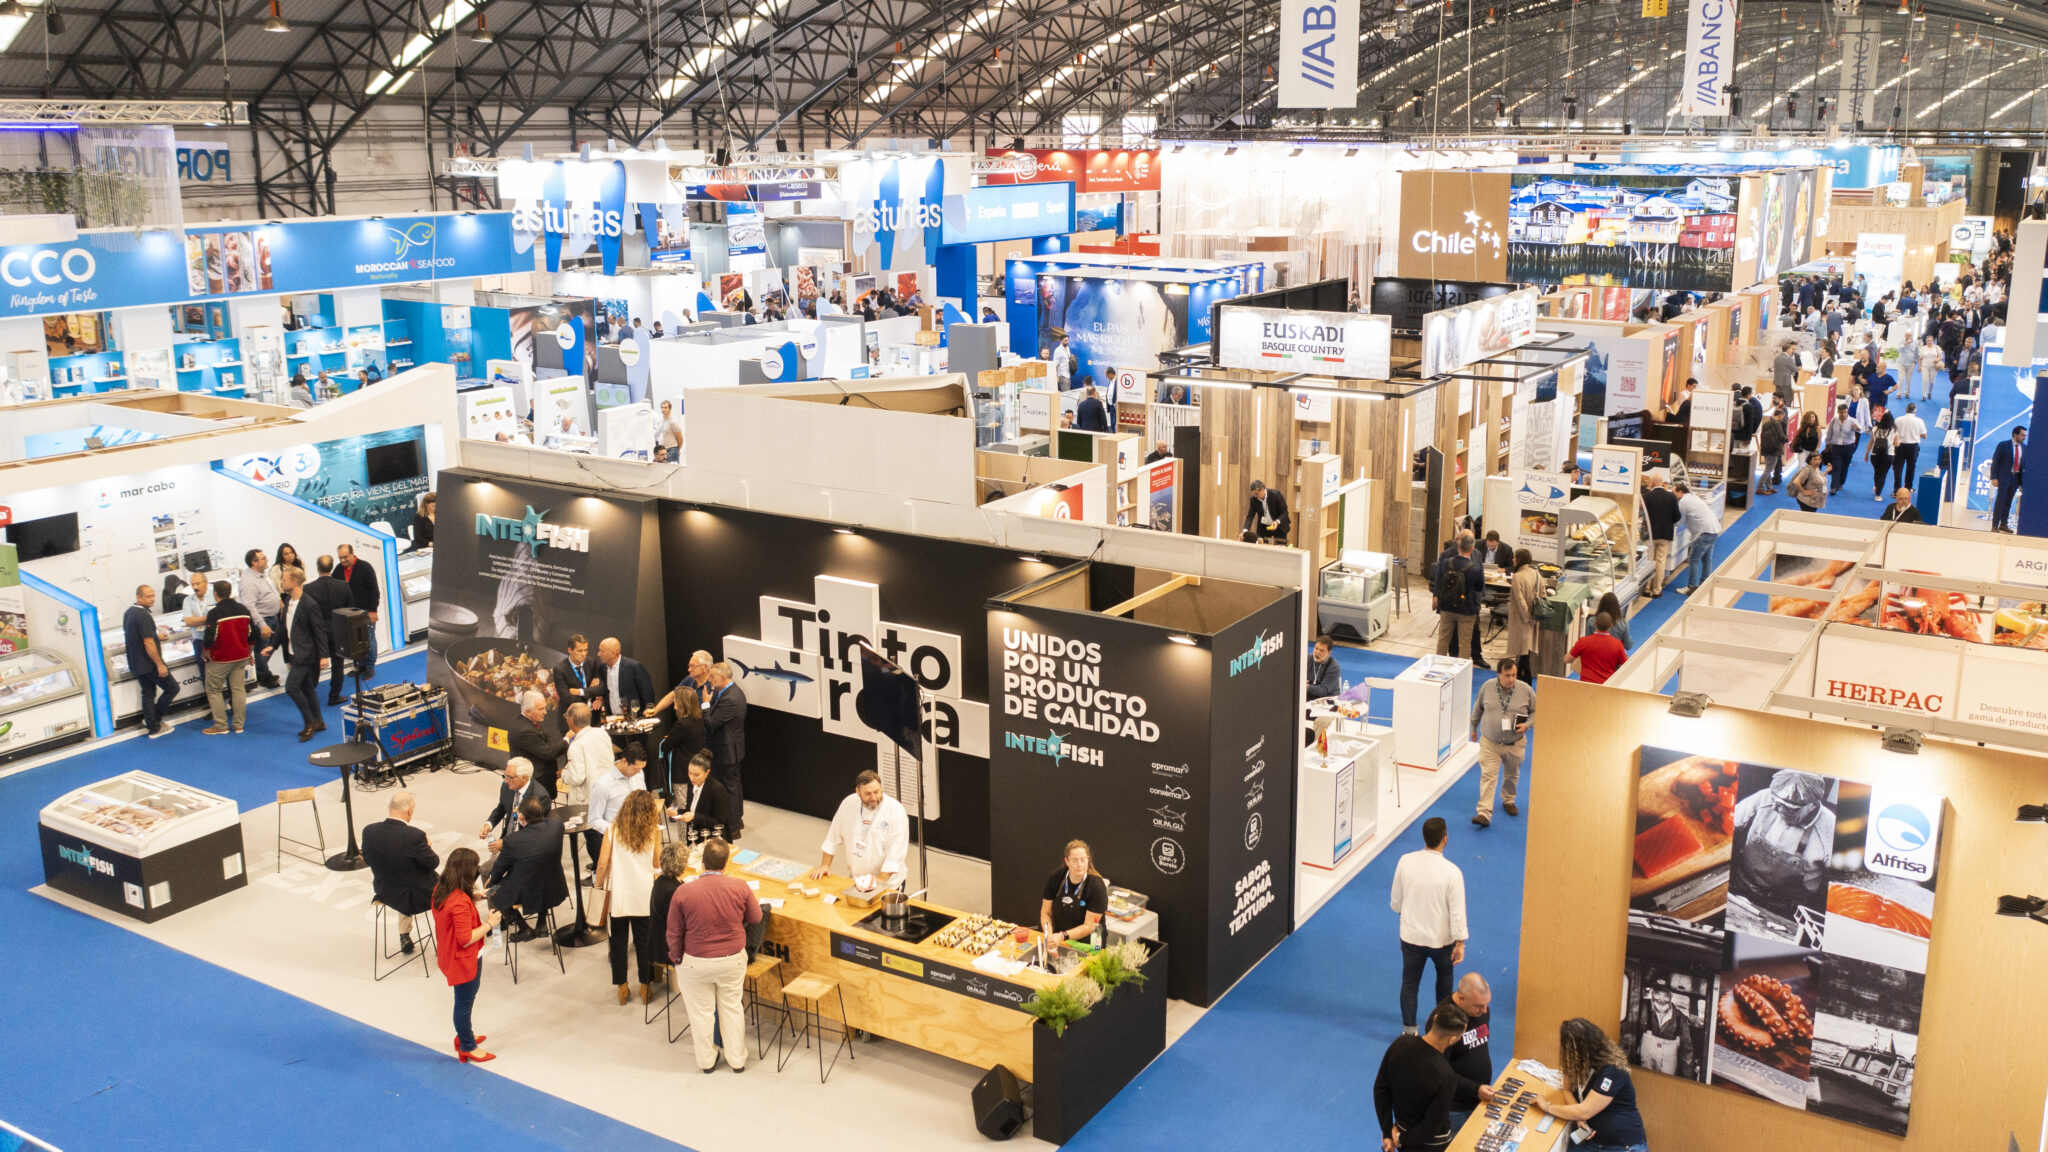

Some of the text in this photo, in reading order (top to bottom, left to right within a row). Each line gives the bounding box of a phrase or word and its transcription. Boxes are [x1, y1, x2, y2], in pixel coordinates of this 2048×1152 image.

[512, 201, 621, 237] asturias
[854, 199, 942, 234] asturias
[1412, 230, 1476, 254] Chile
[355, 257, 456, 274] MOROCCAN SEAFOOD
[10, 287, 98, 312] Kingdom of Taste
[1262, 322, 1345, 343] EUSKADI
[1261, 341, 1345, 356] BASQUE COUNTRY
[120, 480, 176, 499] mar cabo
[366, 484, 391, 498] VIENE
[391, 480, 409, 492] DEL
[410, 475, 429, 487] MAR
[778, 606, 951, 691] Tinto
[1003, 627, 1102, 664] UNIDOS
[1004, 650, 1100, 687] POR UN
[1004, 672, 1147, 718] PRODUCTO
[1826, 679, 1943, 713] HERPAC
[1004, 694, 1161, 743] DE CALIDAD
[1968, 712, 1994, 723] gama
[1995, 714, 2007, 725] de
[1980, 702, 2047, 720] Descubre toda
[1151, 762, 1184, 775] opromar
[1870, 851, 1927, 875] Alfrisa
[1234, 858, 1272, 898] SABOR.
[1228, 894, 1275, 937] TEXTURA.
